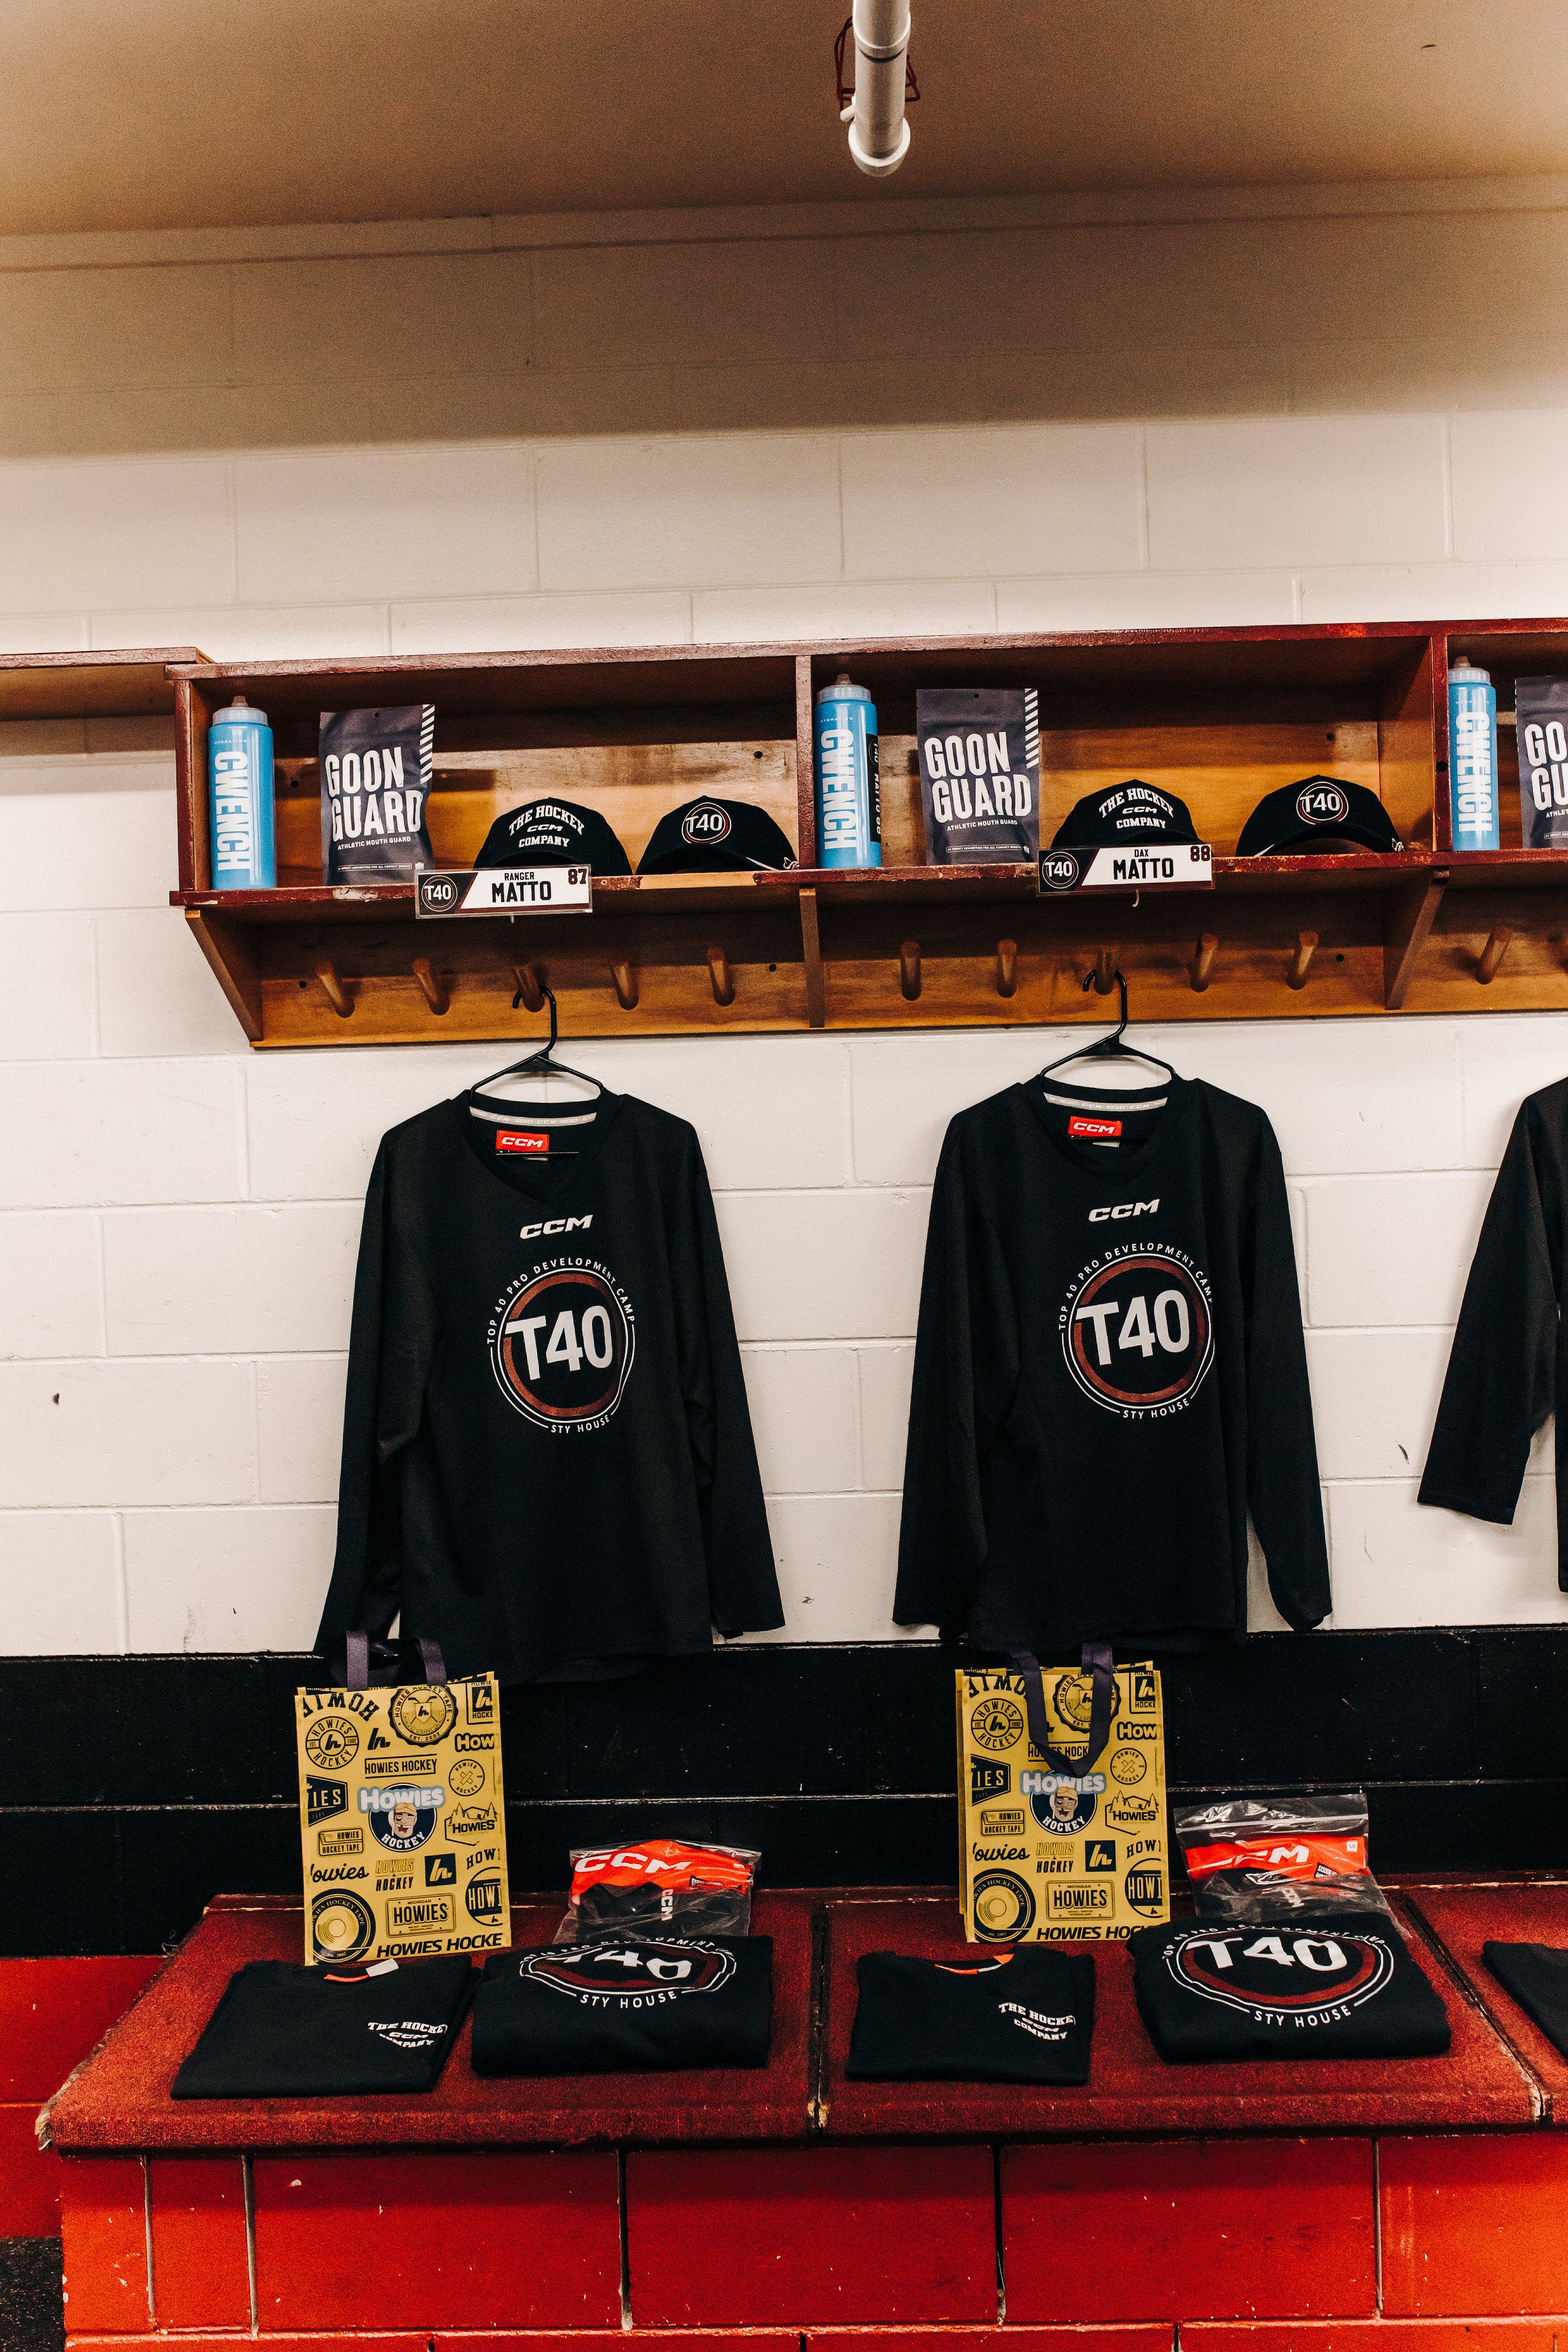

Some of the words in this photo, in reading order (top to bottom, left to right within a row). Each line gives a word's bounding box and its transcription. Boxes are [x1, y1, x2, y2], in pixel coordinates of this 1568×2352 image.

[1524, 721, 1568, 767] GO
[924, 731, 1010, 779] GOON
[325, 746, 405, 798] GOON
[1456, 712, 1493, 832] CWENCH
[821, 729, 857, 849] CWENCH
[931, 774, 1032, 824] GUARD
[1099, 792, 1125, 818] THE
[1126, 788, 1174, 818] HOCKEY
[1299, 793, 1340, 813] T40
[215, 751, 250, 871] CWENCH
[331, 790, 423, 842] GUARD
[509, 809, 532, 836] THE
[536, 805, 585, 835] HOCKEY
[526, 824, 563, 832] CCM
[685, 813, 723, 833] T40
[947, 822, 977, 832] ATHLETIC
[977, 819, 999, 827] MOUTH
[1116, 817, 1165, 829] COMPANY
[337, 840, 366, 850] ATHLETIC
[366, 838, 388, 846] MOUTH
[519, 835, 569, 848] COMPANY
[1134, 849, 1149, 857] DAX
[1190, 845, 1210, 862] 88
[504, 872, 534, 881] RANGER
[568, 868, 587, 885] 87
[1044, 861, 1072, 877] T40
[1113, 858, 1173, 879] MATTO
[424, 884, 452, 901] T40
[492, 881, 552, 903] MATTO
[1073, 1122, 1115, 1134] CCM
[502, 1136, 544, 1148] CCM
[1088, 1199, 1160, 1222] CCM
[519, 1214, 593, 1239] CCM
[1059, 1305, 1068, 1330] TOP
[1066, 1284, 1078, 1299] 40
[1078, 1259, 1099, 1280] PRO
[1104, 1242, 1194, 1268] DEVELOPMENT
[487, 1319, 497, 1344] TOP
[495, 1298, 506, 1313] 40
[506, 1273, 528, 1295] PRO
[533, 1257, 616, 1285] DEVELOPMENT
[616, 1288, 635, 1322] CAMP
[1075, 1288, 1190, 1366] T40
[504, 1305, 613, 1380] T40
[1123, 1410, 1143, 1419] STY
[1150, 1398, 1190, 1419] HOUSE
[551, 1424, 571, 1434] STY
[577, 1413, 611, 1433] HOUSE
[443, 1694, 452, 1713] TAPE
[977, 1701, 1017, 1718] HOWIES
[311, 1719, 352, 1737] HOWIES
[425, 1732, 440, 1741] 2002
[978, 1732, 1016, 1748] HOCKEY
[314, 1749, 352, 1767] HOCKEY
[1116, 1751, 1140, 1760] HOWIES
[365, 1761, 399, 1774] HOWIES
[401, 1759, 437, 1772] HOCKEY
[455, 1762, 478, 1772] HOWIES
[1023, 1772, 1104, 1794] HOWIES
[1117, 1774, 1140, 1782] HOCKEY
[455, 1784, 478, 1794] HOCKEY
[360, 1788, 444, 1811] HOWIES
[999, 1812, 1021, 1820] HOWIES
[1042, 1815, 1085, 1832] HOCKEY
[1113, 1810, 1156, 1821] HOWIES
[337, 1831, 359, 1840] HOWIES
[452, 1820, 495, 1833] HOWIES
[322, 1845, 344, 1854] HOCKEY
[346, 1843, 360, 1851] TAPE
[381, 1831, 425, 1849] HOCKEY
[1036, 1841, 1074, 1856] HOWIES
[375, 1858, 415, 1874] HOWIES
[575, 1852, 691, 1873] CCM
[1036, 1860, 1074, 1873] HOCKEY
[376, 1877, 413, 1892] HOCKEY
[987, 1879, 1015, 1890] HOCKEY
[1015, 1889, 1025, 1907] TAPE
[661, 1888, 674, 1921] CCM
[1054, 1889, 1107, 1907] HOWIES
[326, 1900, 355, 1909] HOCKEY
[355, 1908, 365, 1926] TAPE
[393, 1903, 448, 1924] HOWIES
[1036, 1927, 1101, 1940] HOWIES
[377, 1939, 442, 1958] HOWIES
[1185, 1936, 1347, 1971] T40
[581, 1994, 610, 2008] STY
[620, 1990, 677, 2009] HOUSE
[998, 2002, 1026, 2016] THE
[1254, 2010, 1285, 2026] STY
[1295, 2005, 1351, 2028] HOUSE
[1014, 2018, 1067, 2040] COMPANY
